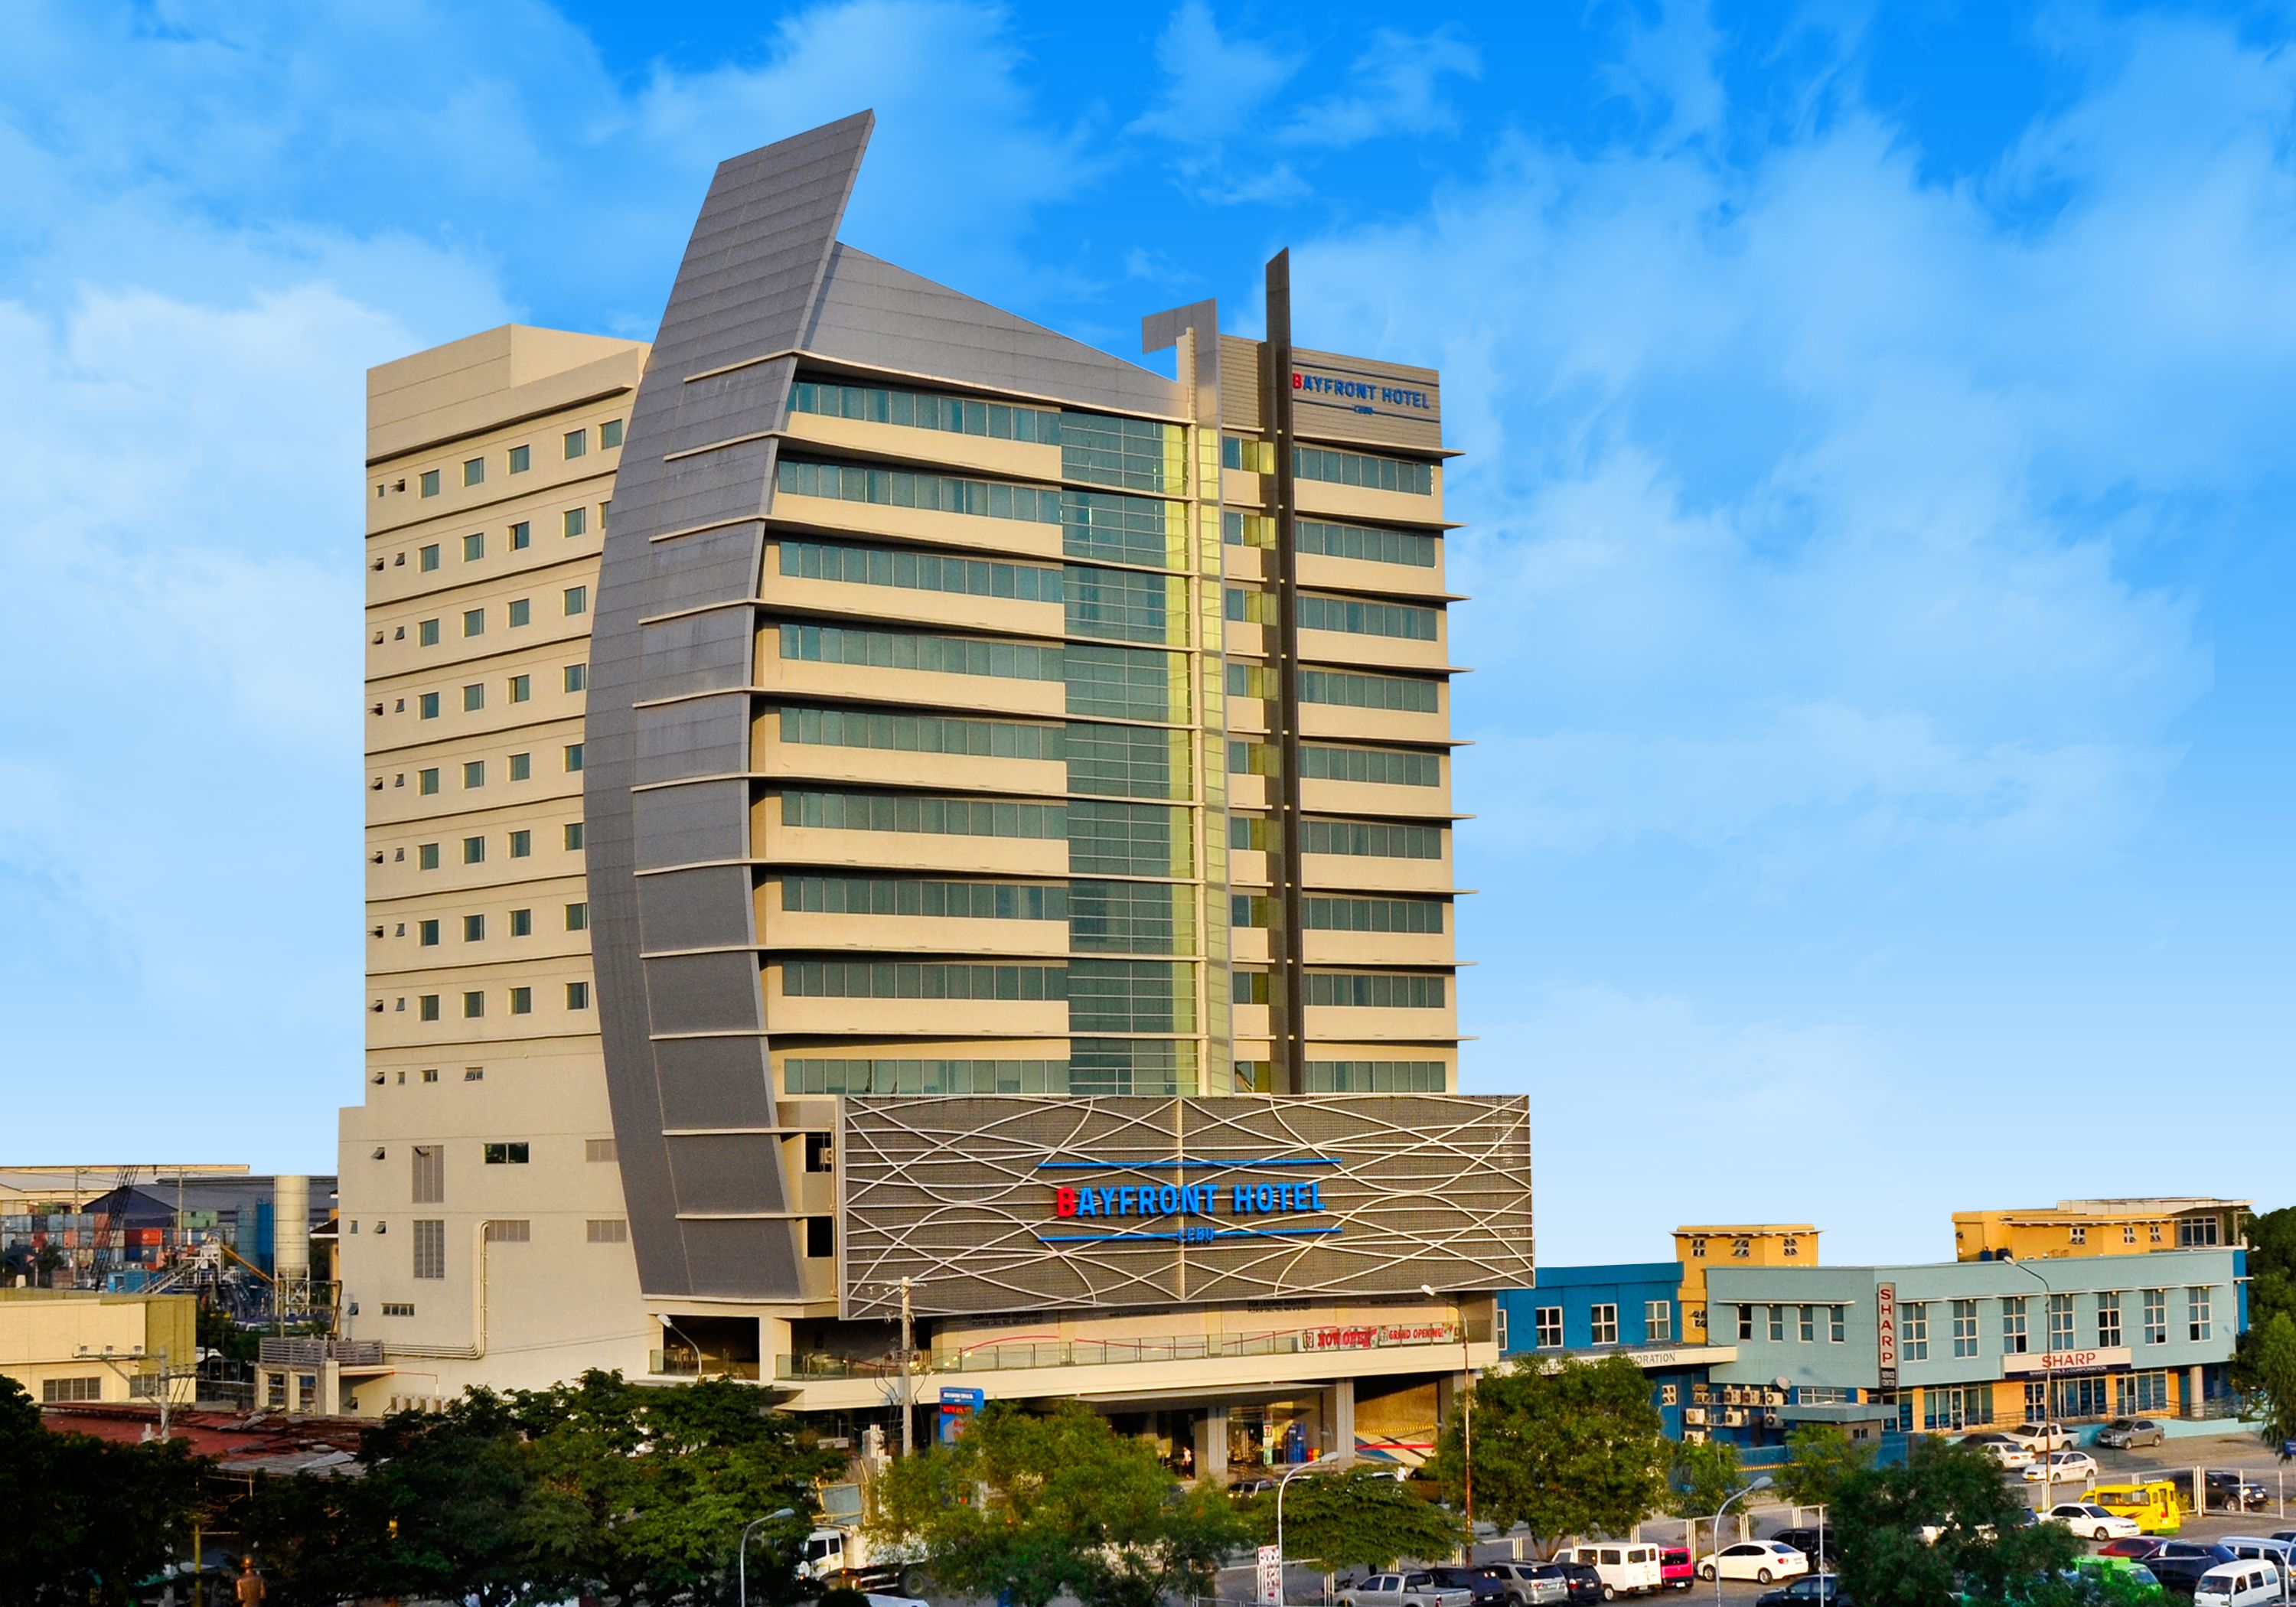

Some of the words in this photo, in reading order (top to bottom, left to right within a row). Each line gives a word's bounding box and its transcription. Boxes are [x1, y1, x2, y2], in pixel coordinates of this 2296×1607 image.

[1293, 373, 1377, 400] BAYFRONT
[1382, 387, 1430, 409] HOTEL
[1057, 1185, 1218, 1218] BAYFRONT
[1233, 1182, 1326, 1213] HOTEL
[1177, 1227, 1215, 1244] CEBU
[1880, 1289, 1893, 1363] SHARP
[2041, 1352, 2096, 1368] SHARP
